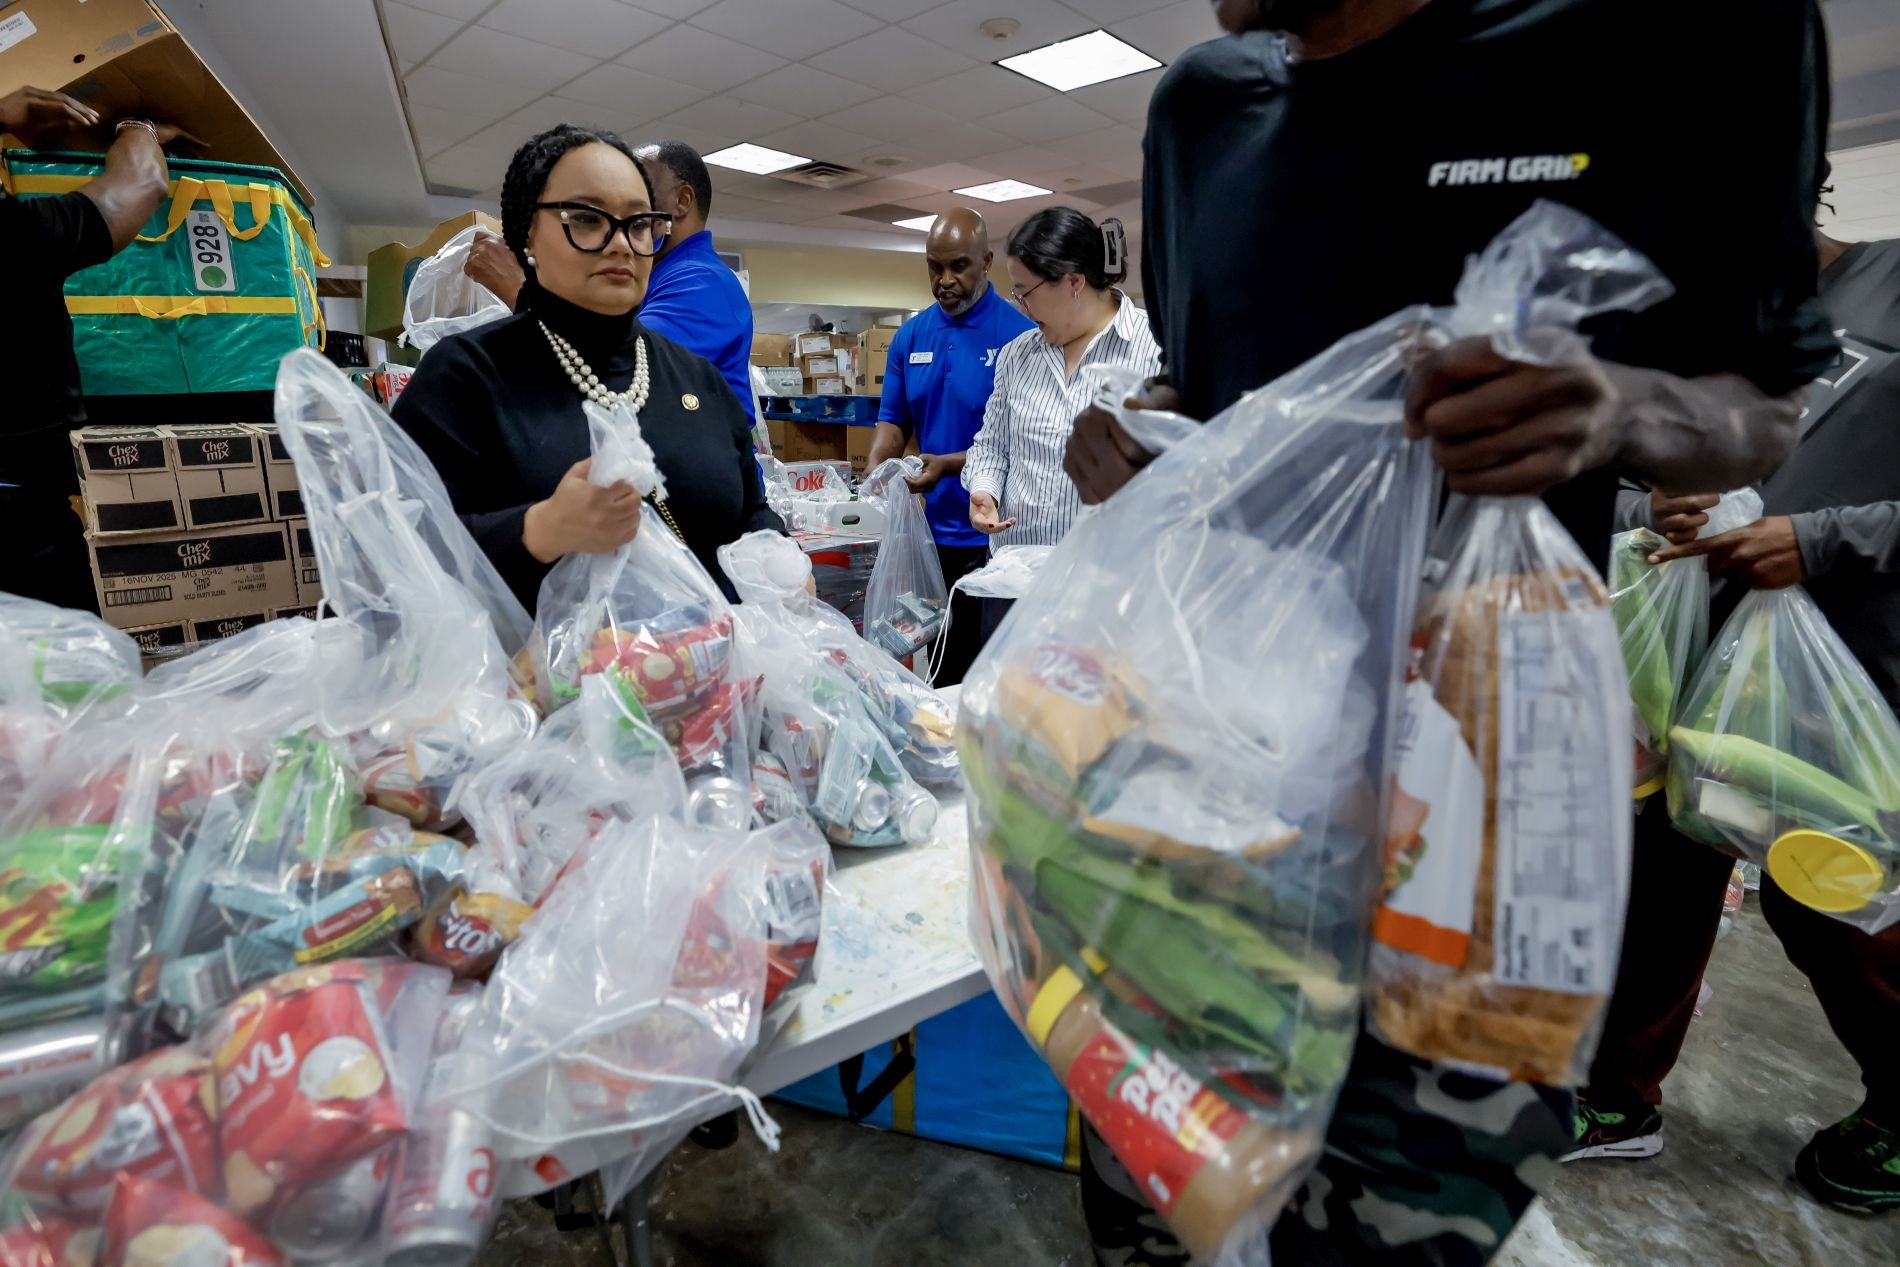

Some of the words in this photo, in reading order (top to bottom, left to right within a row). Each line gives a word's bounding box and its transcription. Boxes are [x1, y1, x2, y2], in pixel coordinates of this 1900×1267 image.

[1427, 157, 1506, 187] FIRM
[1506, 153, 1590, 182] GRIP
[192, 225, 223, 264] 928
[108, 443, 139, 458] Chex
[201, 439, 229, 453] Chex
[113, 452, 139, 467] mix
[206, 447, 230, 462] mix
[177, 540, 210, 557] Chex
[183, 549, 211, 567] mix
[217, 619, 243, 634] Chex
[220, 1031, 297, 1110] avy
